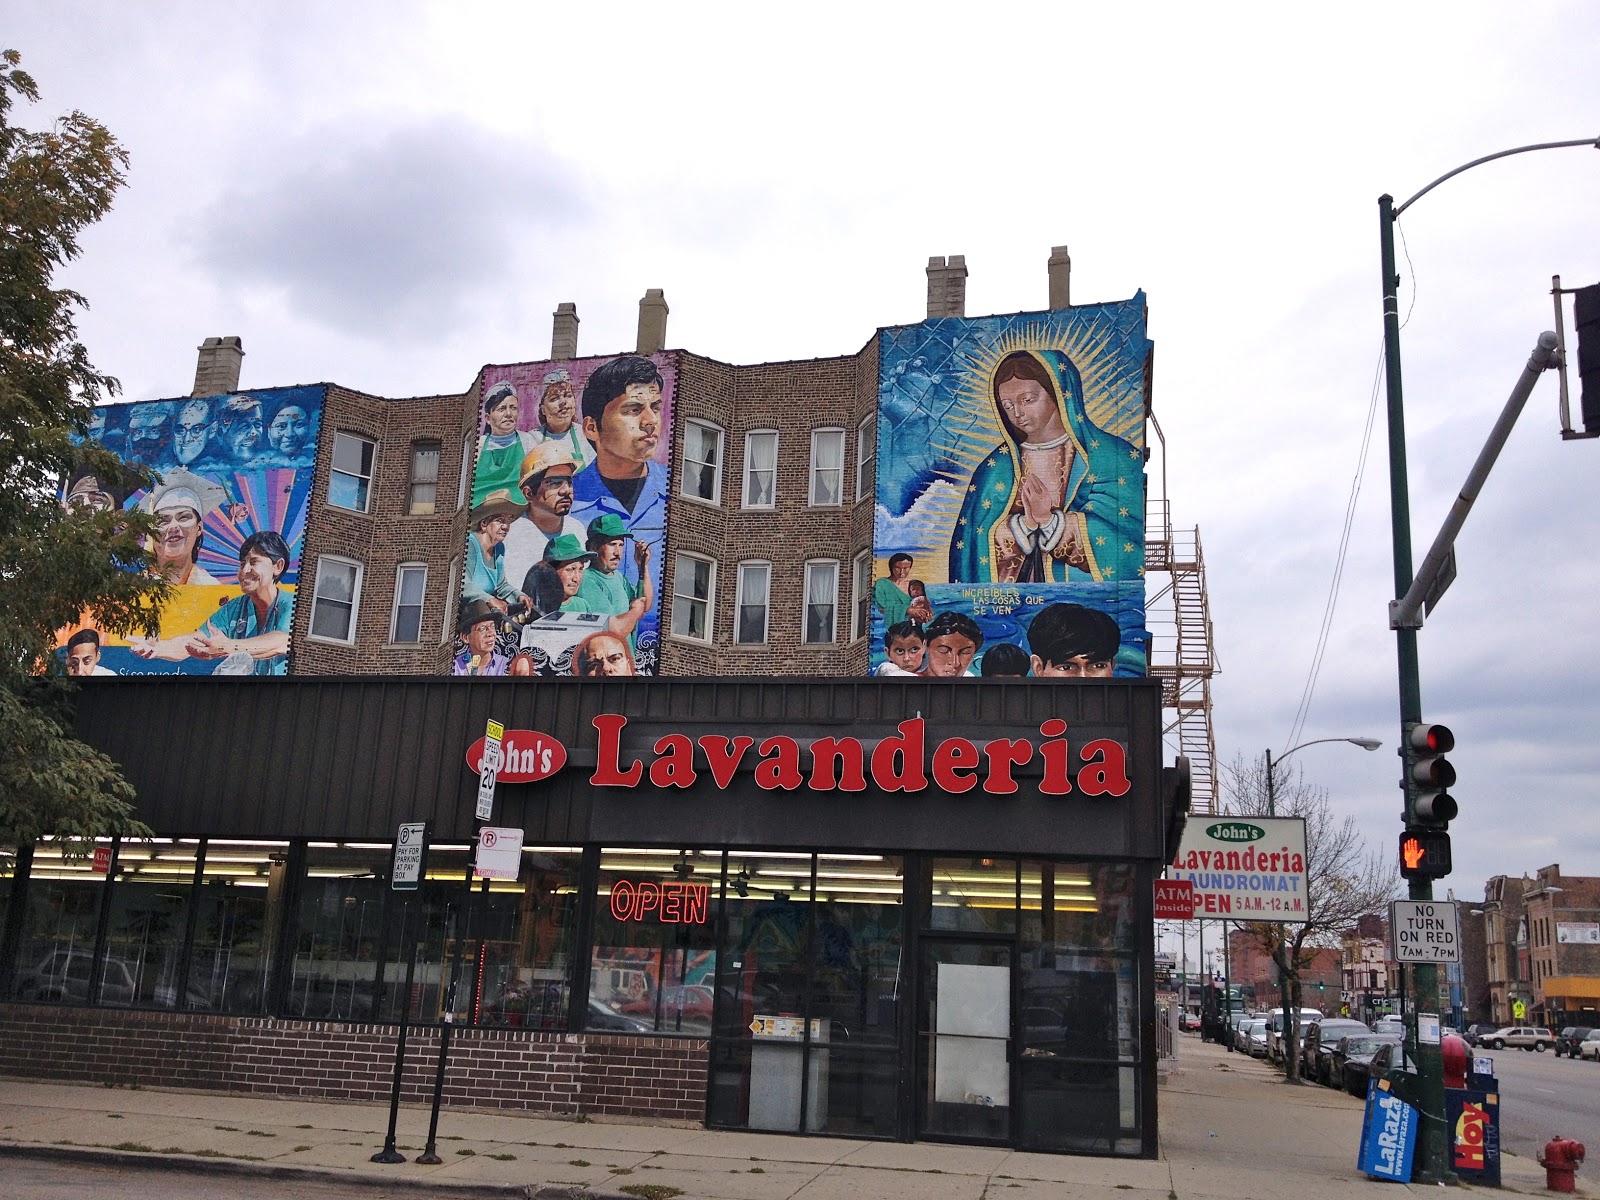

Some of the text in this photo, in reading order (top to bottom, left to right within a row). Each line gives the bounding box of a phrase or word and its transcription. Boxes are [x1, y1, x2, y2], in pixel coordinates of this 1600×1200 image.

[973, 595, 1045, 605] LAS COSAS QUE
[973, 605, 1013, 615] SE VEN
[487, 723, 502, 739] SCHOOL
[486, 740, 500, 755] SPEED
[477, 739, 553, 774] ohn's
[590, 713, 1132, 797] Lavanderia
[481, 766, 495, 790] 20
[1213, 825, 1258, 840] John's
[95, 852, 110, 862] ATM
[397, 847, 419, 856] PAY FOR
[396, 855, 420, 863] PARKING
[1173, 845, 1304, 873] Lavanderia
[396, 863, 414, 871] AT PAY
[395, 871, 406, 879] BOX
[1156, 887, 1192, 901] ATM
[610, 880, 708, 924] OPEN
[1155, 903, 1192, 913] Inside
[1193, 894, 1231, 913] PEN
[1236, 896, 1242, 910] 5
[1415, 905, 1435, 917] NO
[1407, 918, 1444, 930] TURN
[1400, 930, 1454, 943] ON RED
[1400, 945, 1423, 957] 7AM
[1432, 946, 1455, 958] 7PM
[1374, 1096, 1402, 1175] LaRaza
